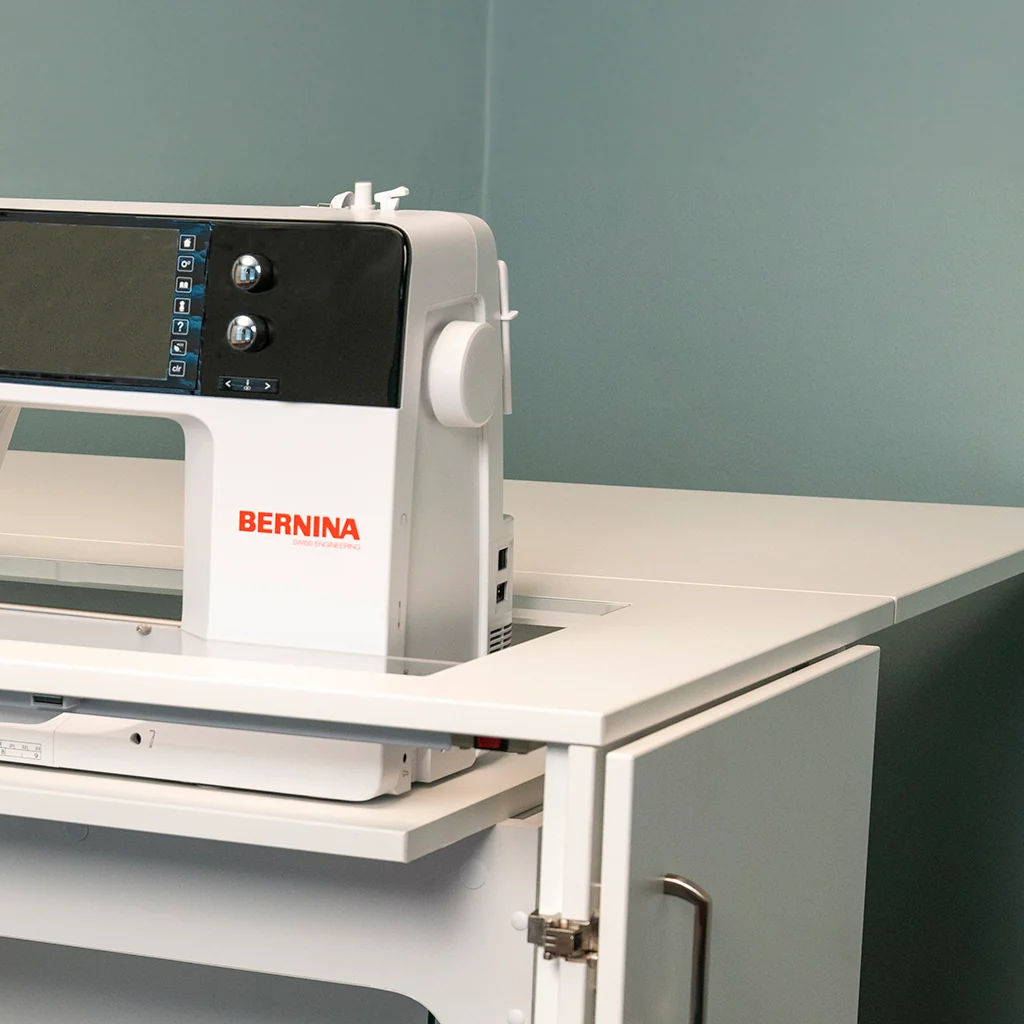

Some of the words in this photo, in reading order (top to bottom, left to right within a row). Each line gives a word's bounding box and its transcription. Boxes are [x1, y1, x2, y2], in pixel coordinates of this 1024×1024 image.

[239, 510, 360, 541] BERNINA
[292, 538, 313, 547] SWISS
[314, 540, 361, 551] ENGINEERING
